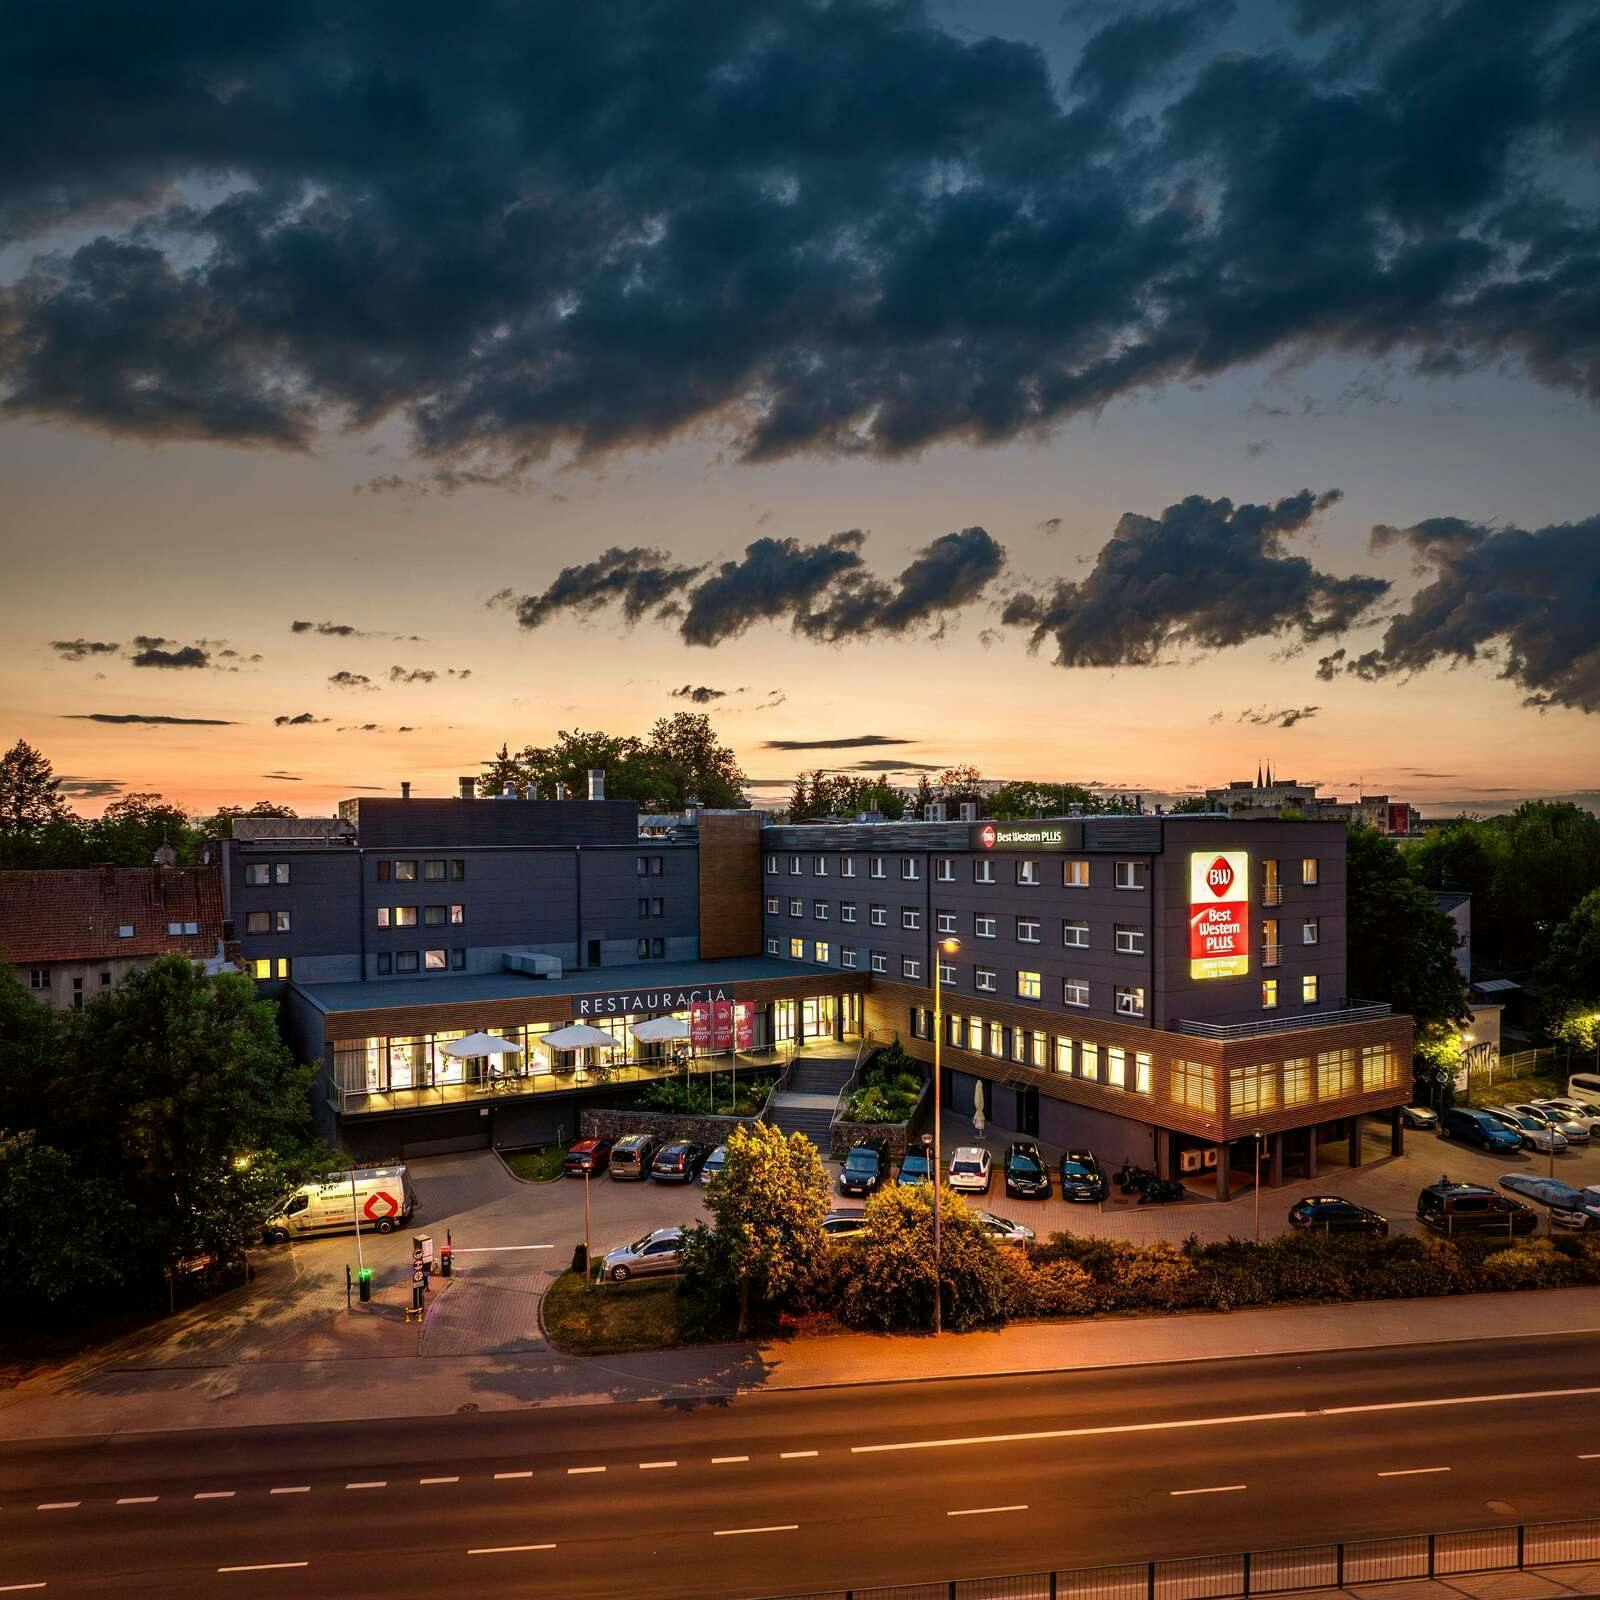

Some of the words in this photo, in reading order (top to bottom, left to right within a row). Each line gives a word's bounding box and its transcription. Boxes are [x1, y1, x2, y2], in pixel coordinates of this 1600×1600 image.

[997, 832, 1012, 842] Best
[1012, 832, 1041, 842] Western
[1041, 831, 1062, 842] PLUS
[1210, 869, 1231, 885] BW
[1209, 909, 1232, 922] Best
[1199, 922, 1240, 936] Western
